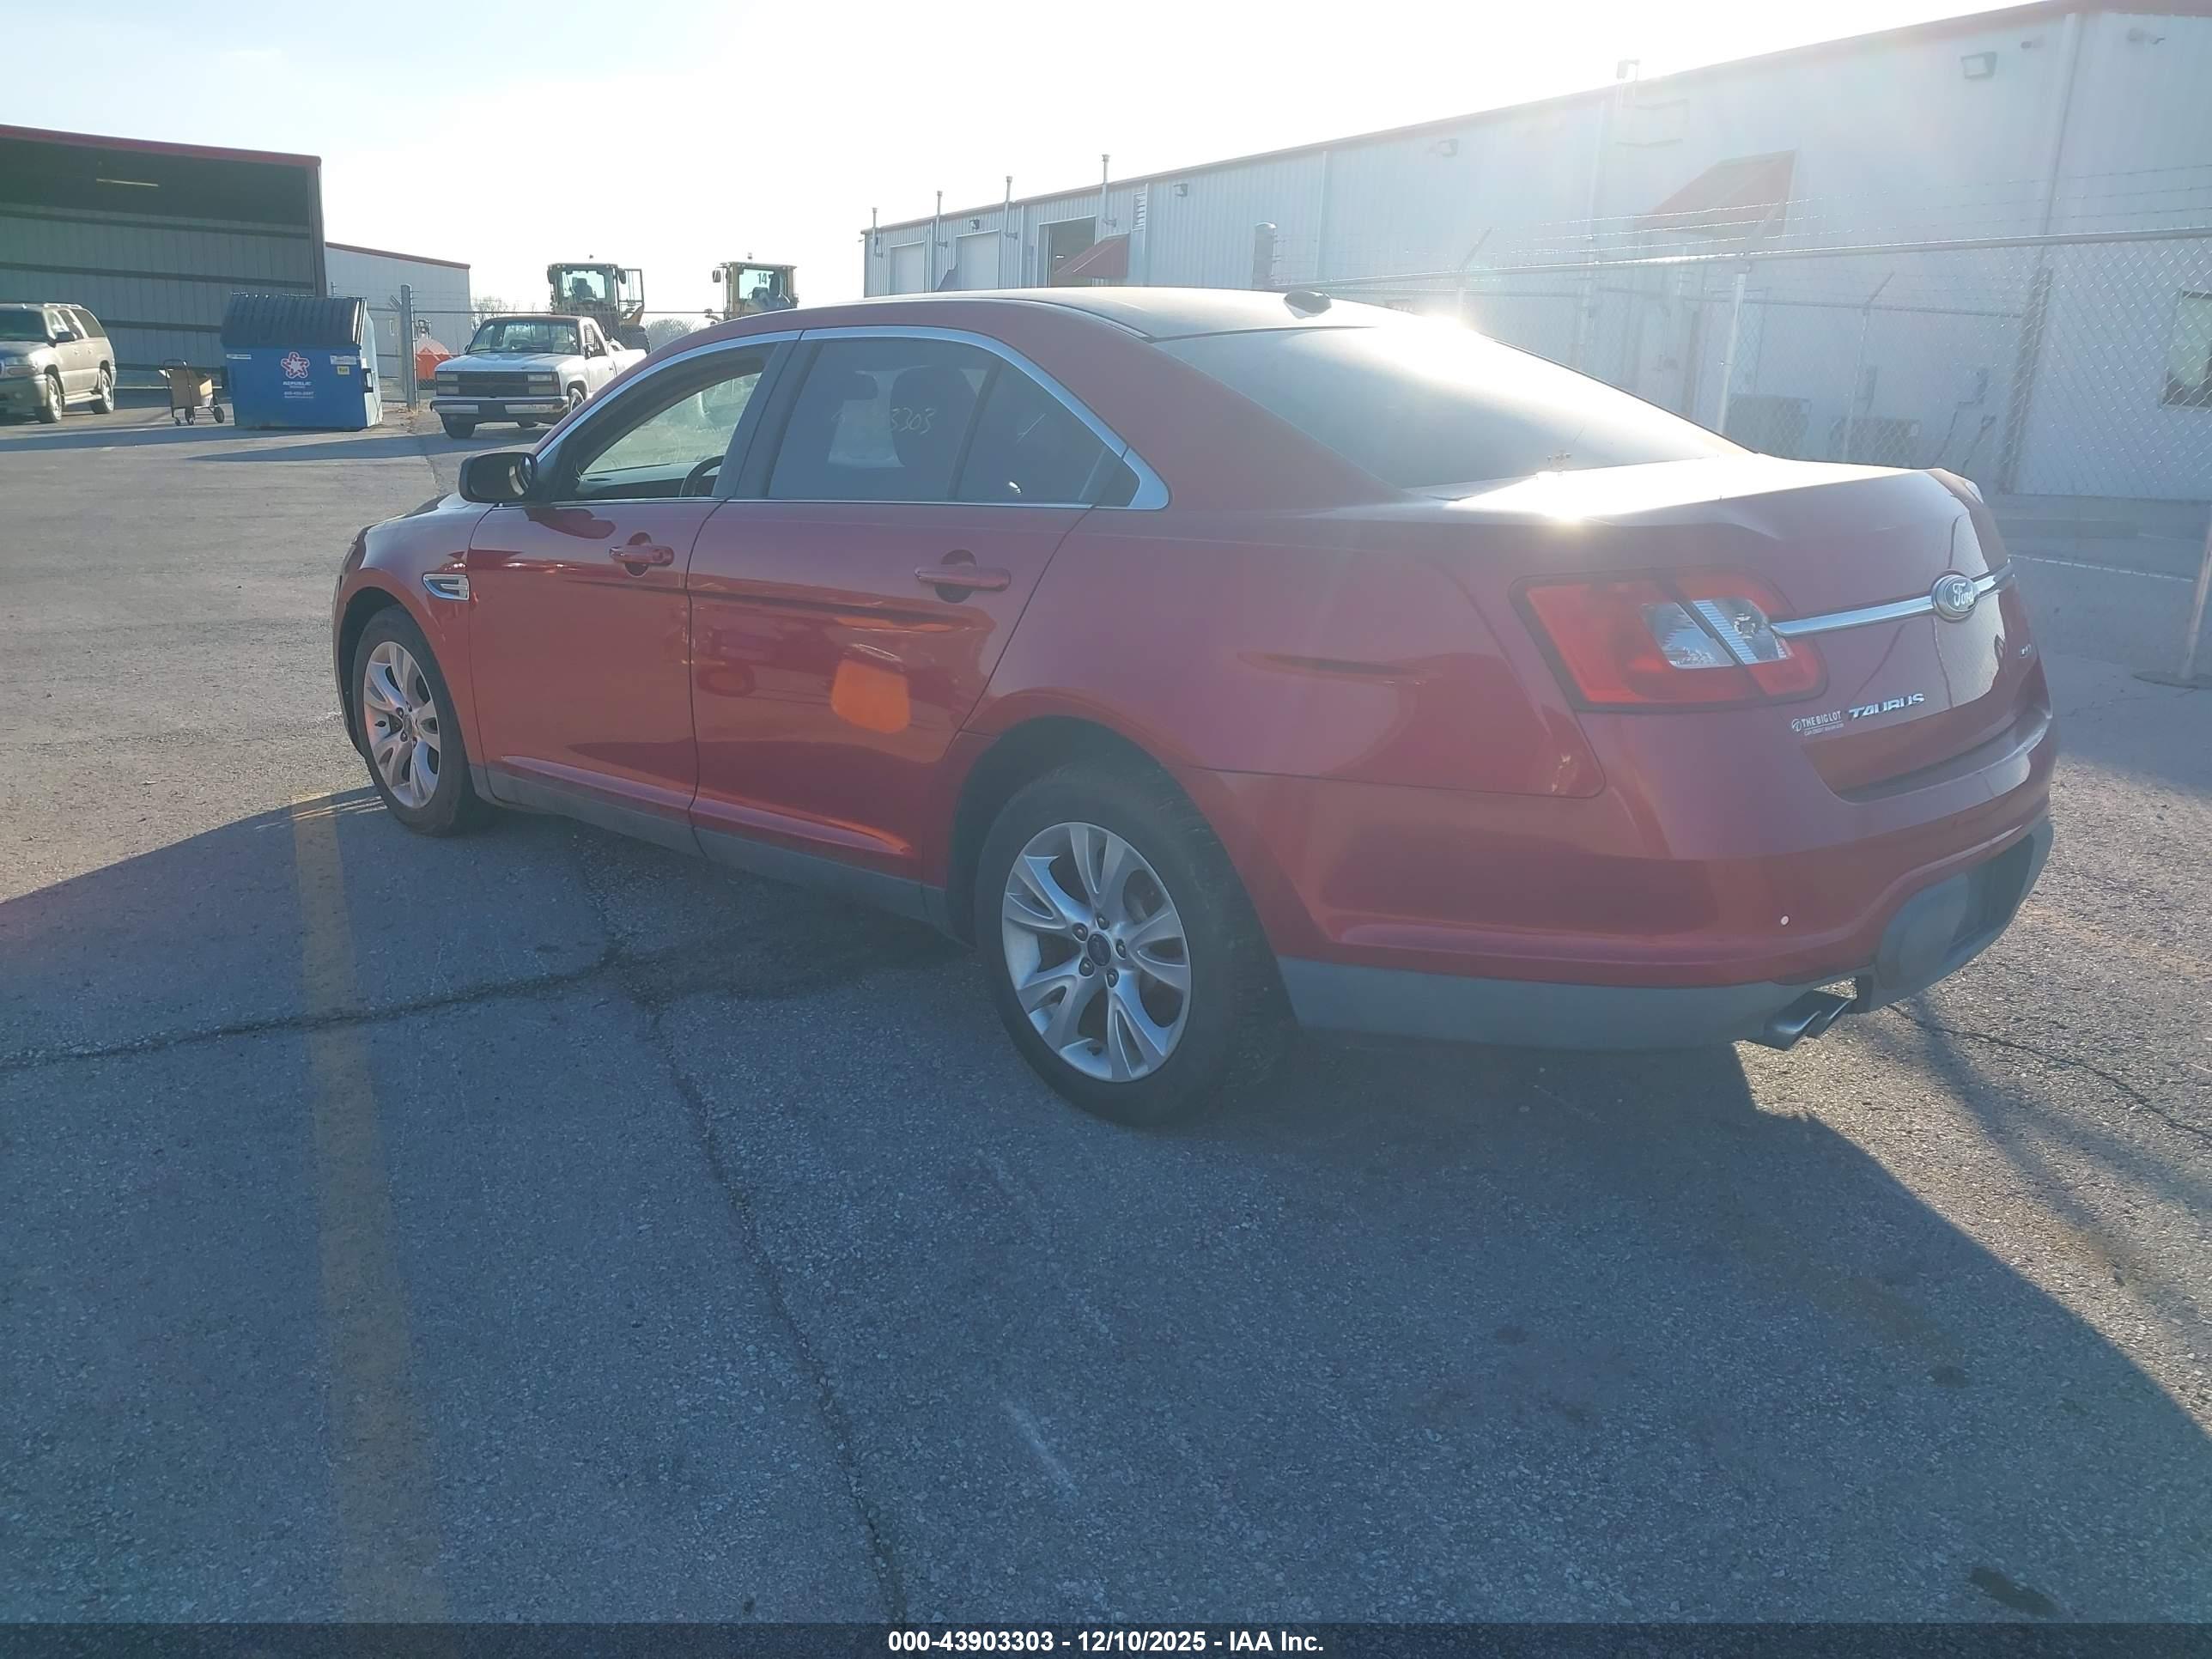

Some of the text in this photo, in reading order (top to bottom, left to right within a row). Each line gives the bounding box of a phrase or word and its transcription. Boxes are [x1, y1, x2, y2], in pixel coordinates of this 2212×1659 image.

[757, 272, 768, 285] 14
[1952, 581, 1975, 607] Ford
[1848, 693, 1925, 719] TAURUS
[1801, 710, 1842, 728] THE BIG LOT
